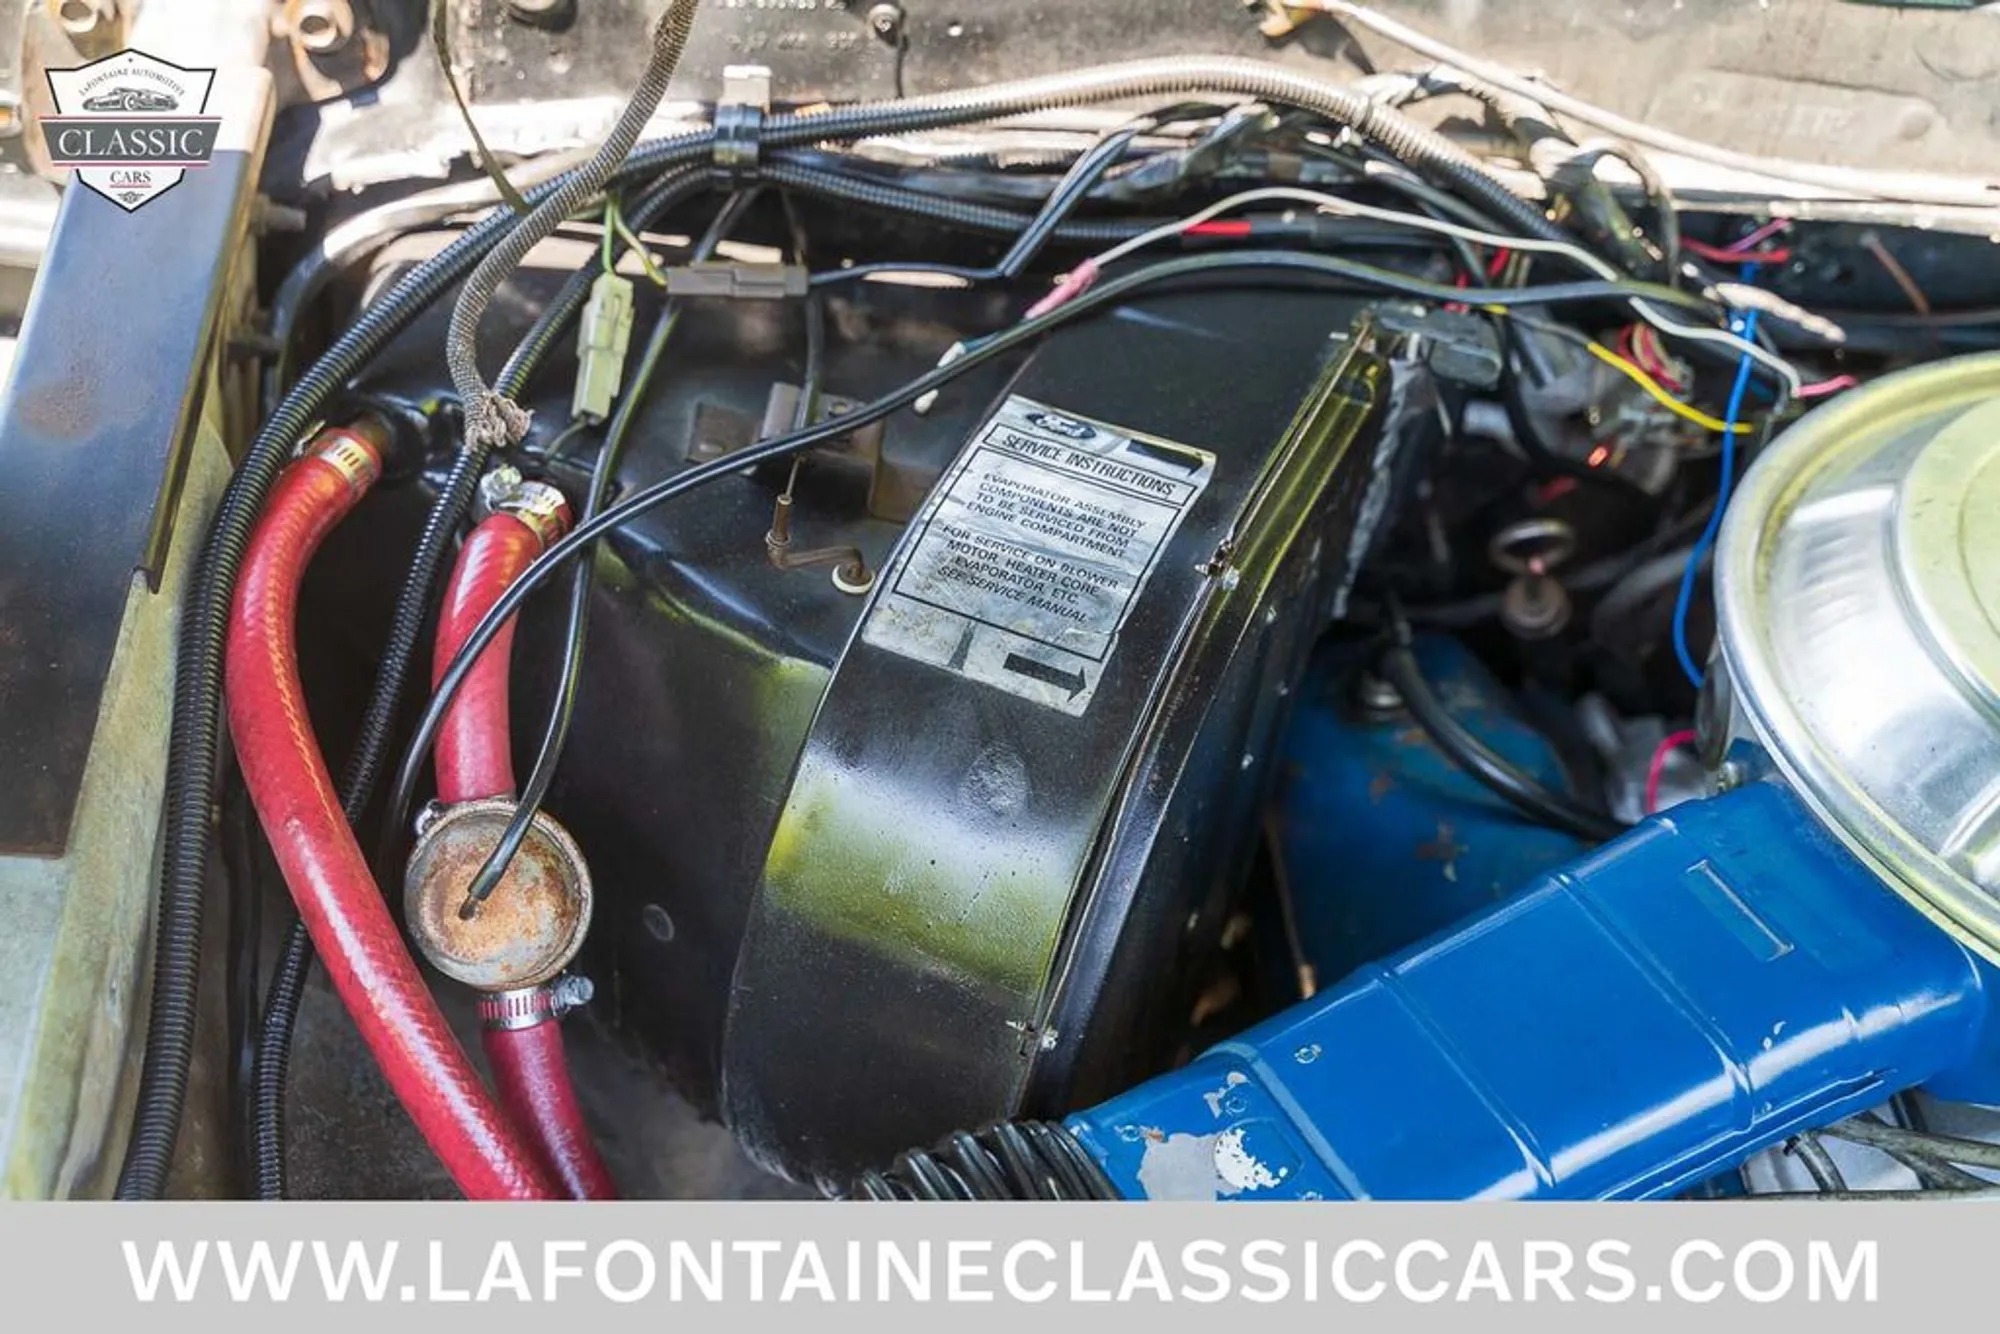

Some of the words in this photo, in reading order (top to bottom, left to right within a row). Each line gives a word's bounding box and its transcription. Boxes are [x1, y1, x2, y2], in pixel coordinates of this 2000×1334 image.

[1034, 413, 1090, 438] Ford
[1002, 434, 1062, 462] SERVICE
[1066, 452, 1177, 497] INSTRUCTIONS
[966, 501, 1016, 523] ENGINE
[1019, 517, 1127, 559] COMPARTMENT
[976, 491, 994, 504] TO
[998, 499, 1016, 511] BE
[1019, 505, 1084, 533] SERVICED
[1087, 526, 1130, 549] FROM
[979, 482, 1073, 518] COMPONENTS
[1076, 513, 1106, 529] ARE
[1108, 522, 1139, 538] NOT
[984, 473, 1071, 504] EVAPORATOR
[1074, 499, 1147, 529] ASSEMBLY
[942, 524, 971, 541] FOR
[974, 532, 1032, 561] SERVICE
[1034, 554, 1057, 569] ON
[1059, 562, 1119, 590] BLOWER
[1005, 559, 1058, 584] HEATER
[938, 566, 966, 581] SEE
[966, 574, 1028, 604] SERVICE
[1026, 597, 1088, 624] MANUAL
